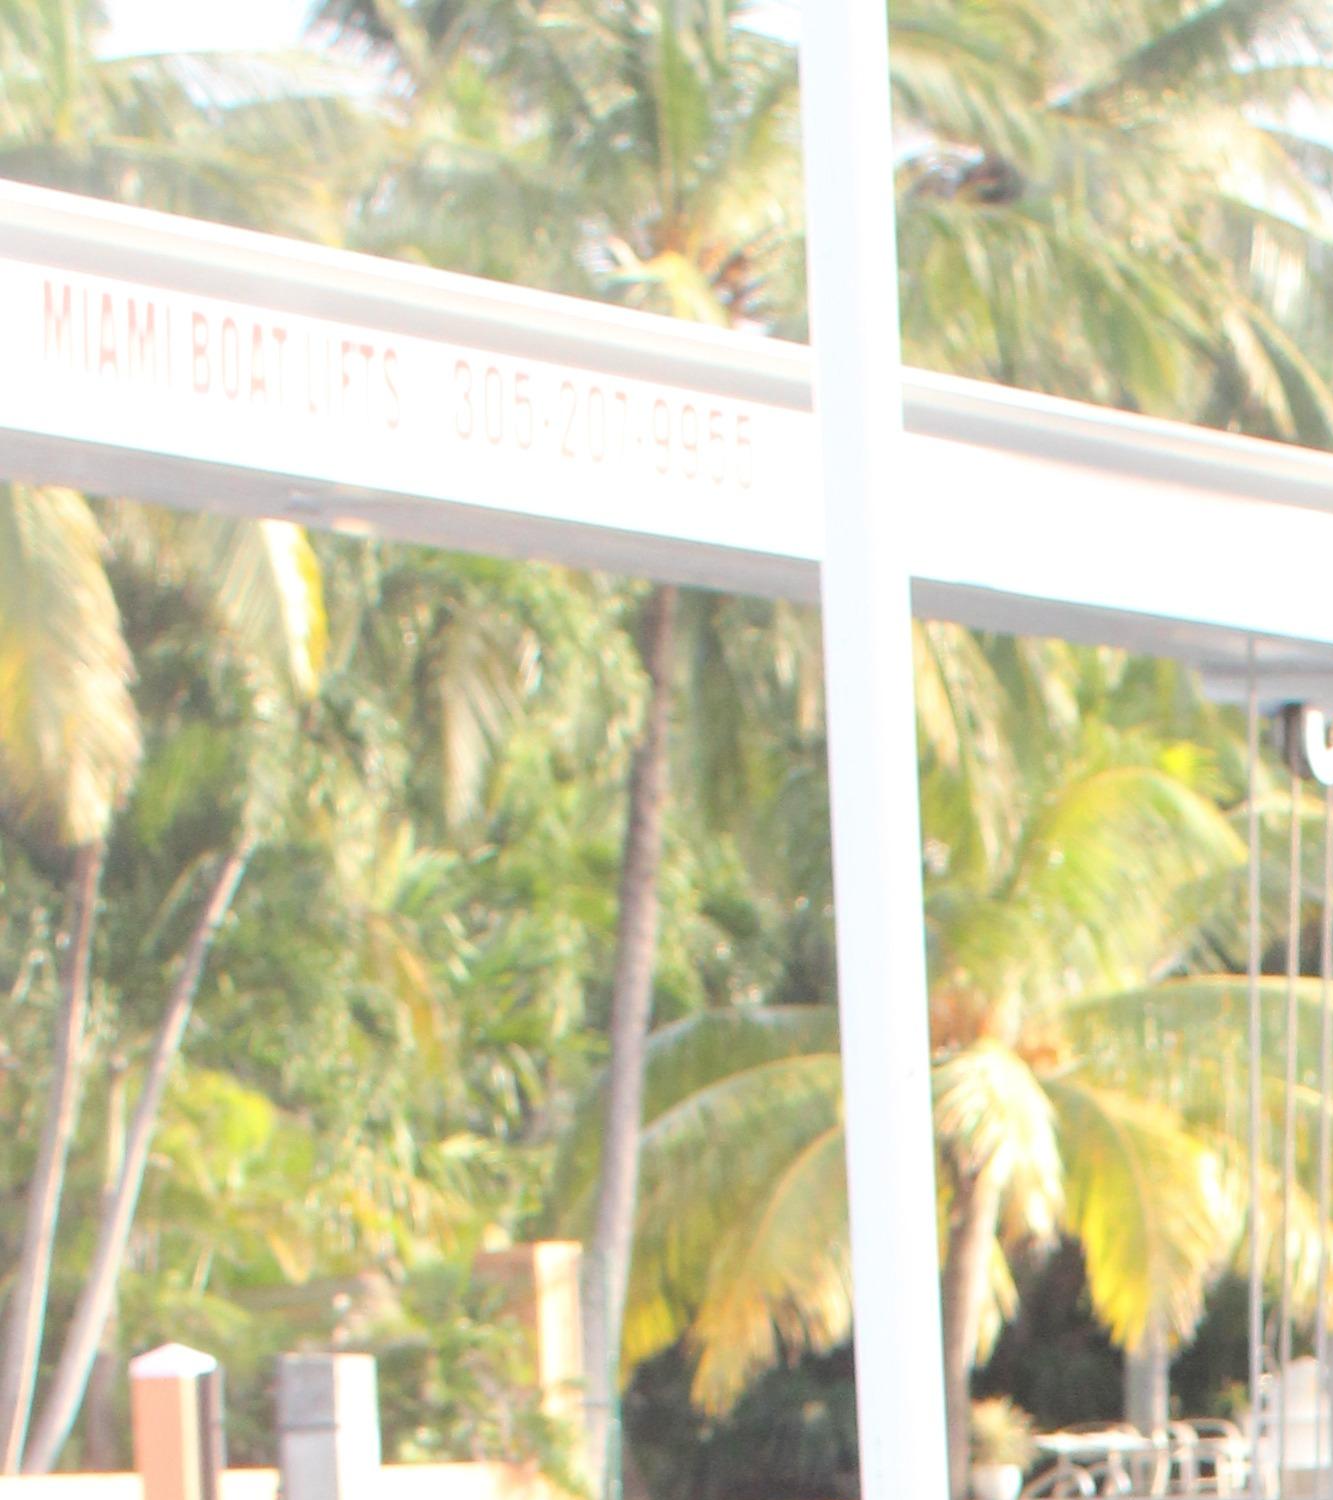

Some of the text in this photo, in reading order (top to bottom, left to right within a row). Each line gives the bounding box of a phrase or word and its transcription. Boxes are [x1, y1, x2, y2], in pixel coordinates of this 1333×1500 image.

[43, 280, 175, 388] MIAMI
[192, 309, 290, 410] BOAT
[306, 332, 403, 431] LIFTS
